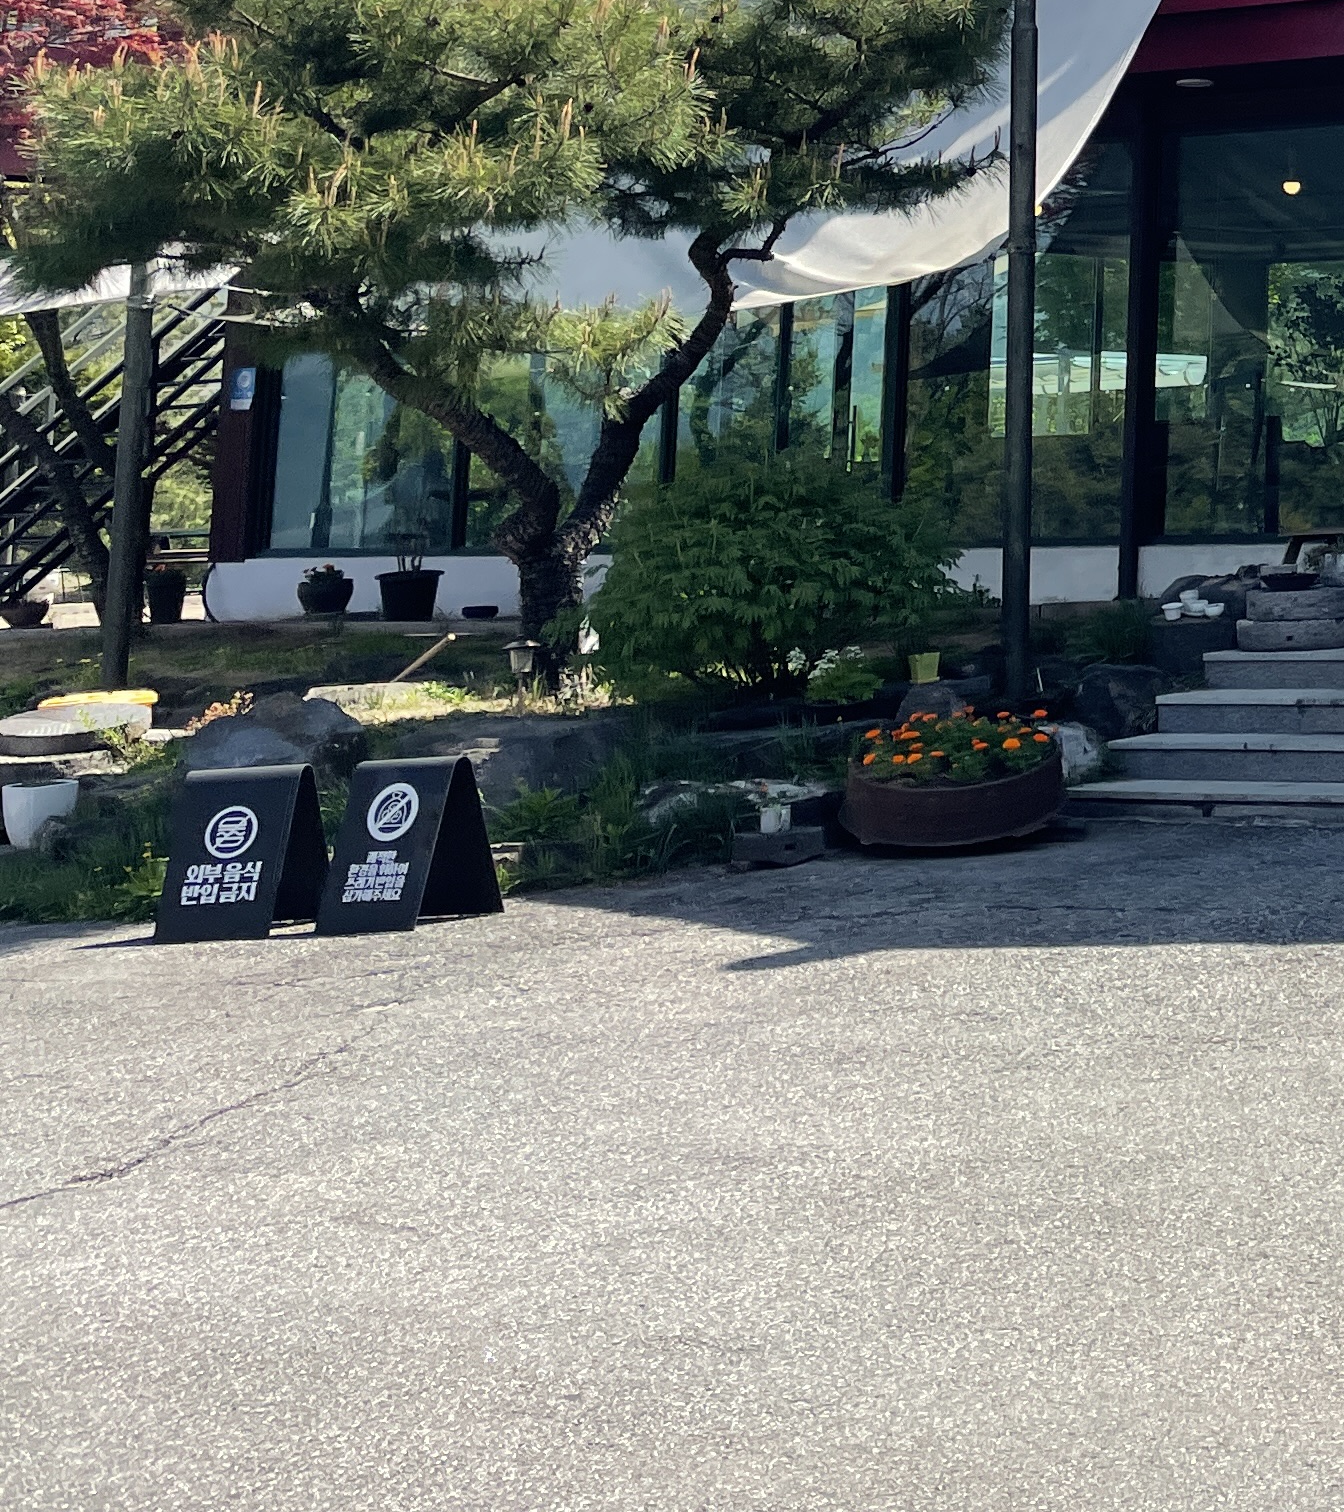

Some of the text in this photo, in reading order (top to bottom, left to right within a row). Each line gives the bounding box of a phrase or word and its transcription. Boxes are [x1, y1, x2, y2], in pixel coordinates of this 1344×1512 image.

[184, 860, 263, 884] 외부 음식
[180, 881, 258, 905] 반입 금지
